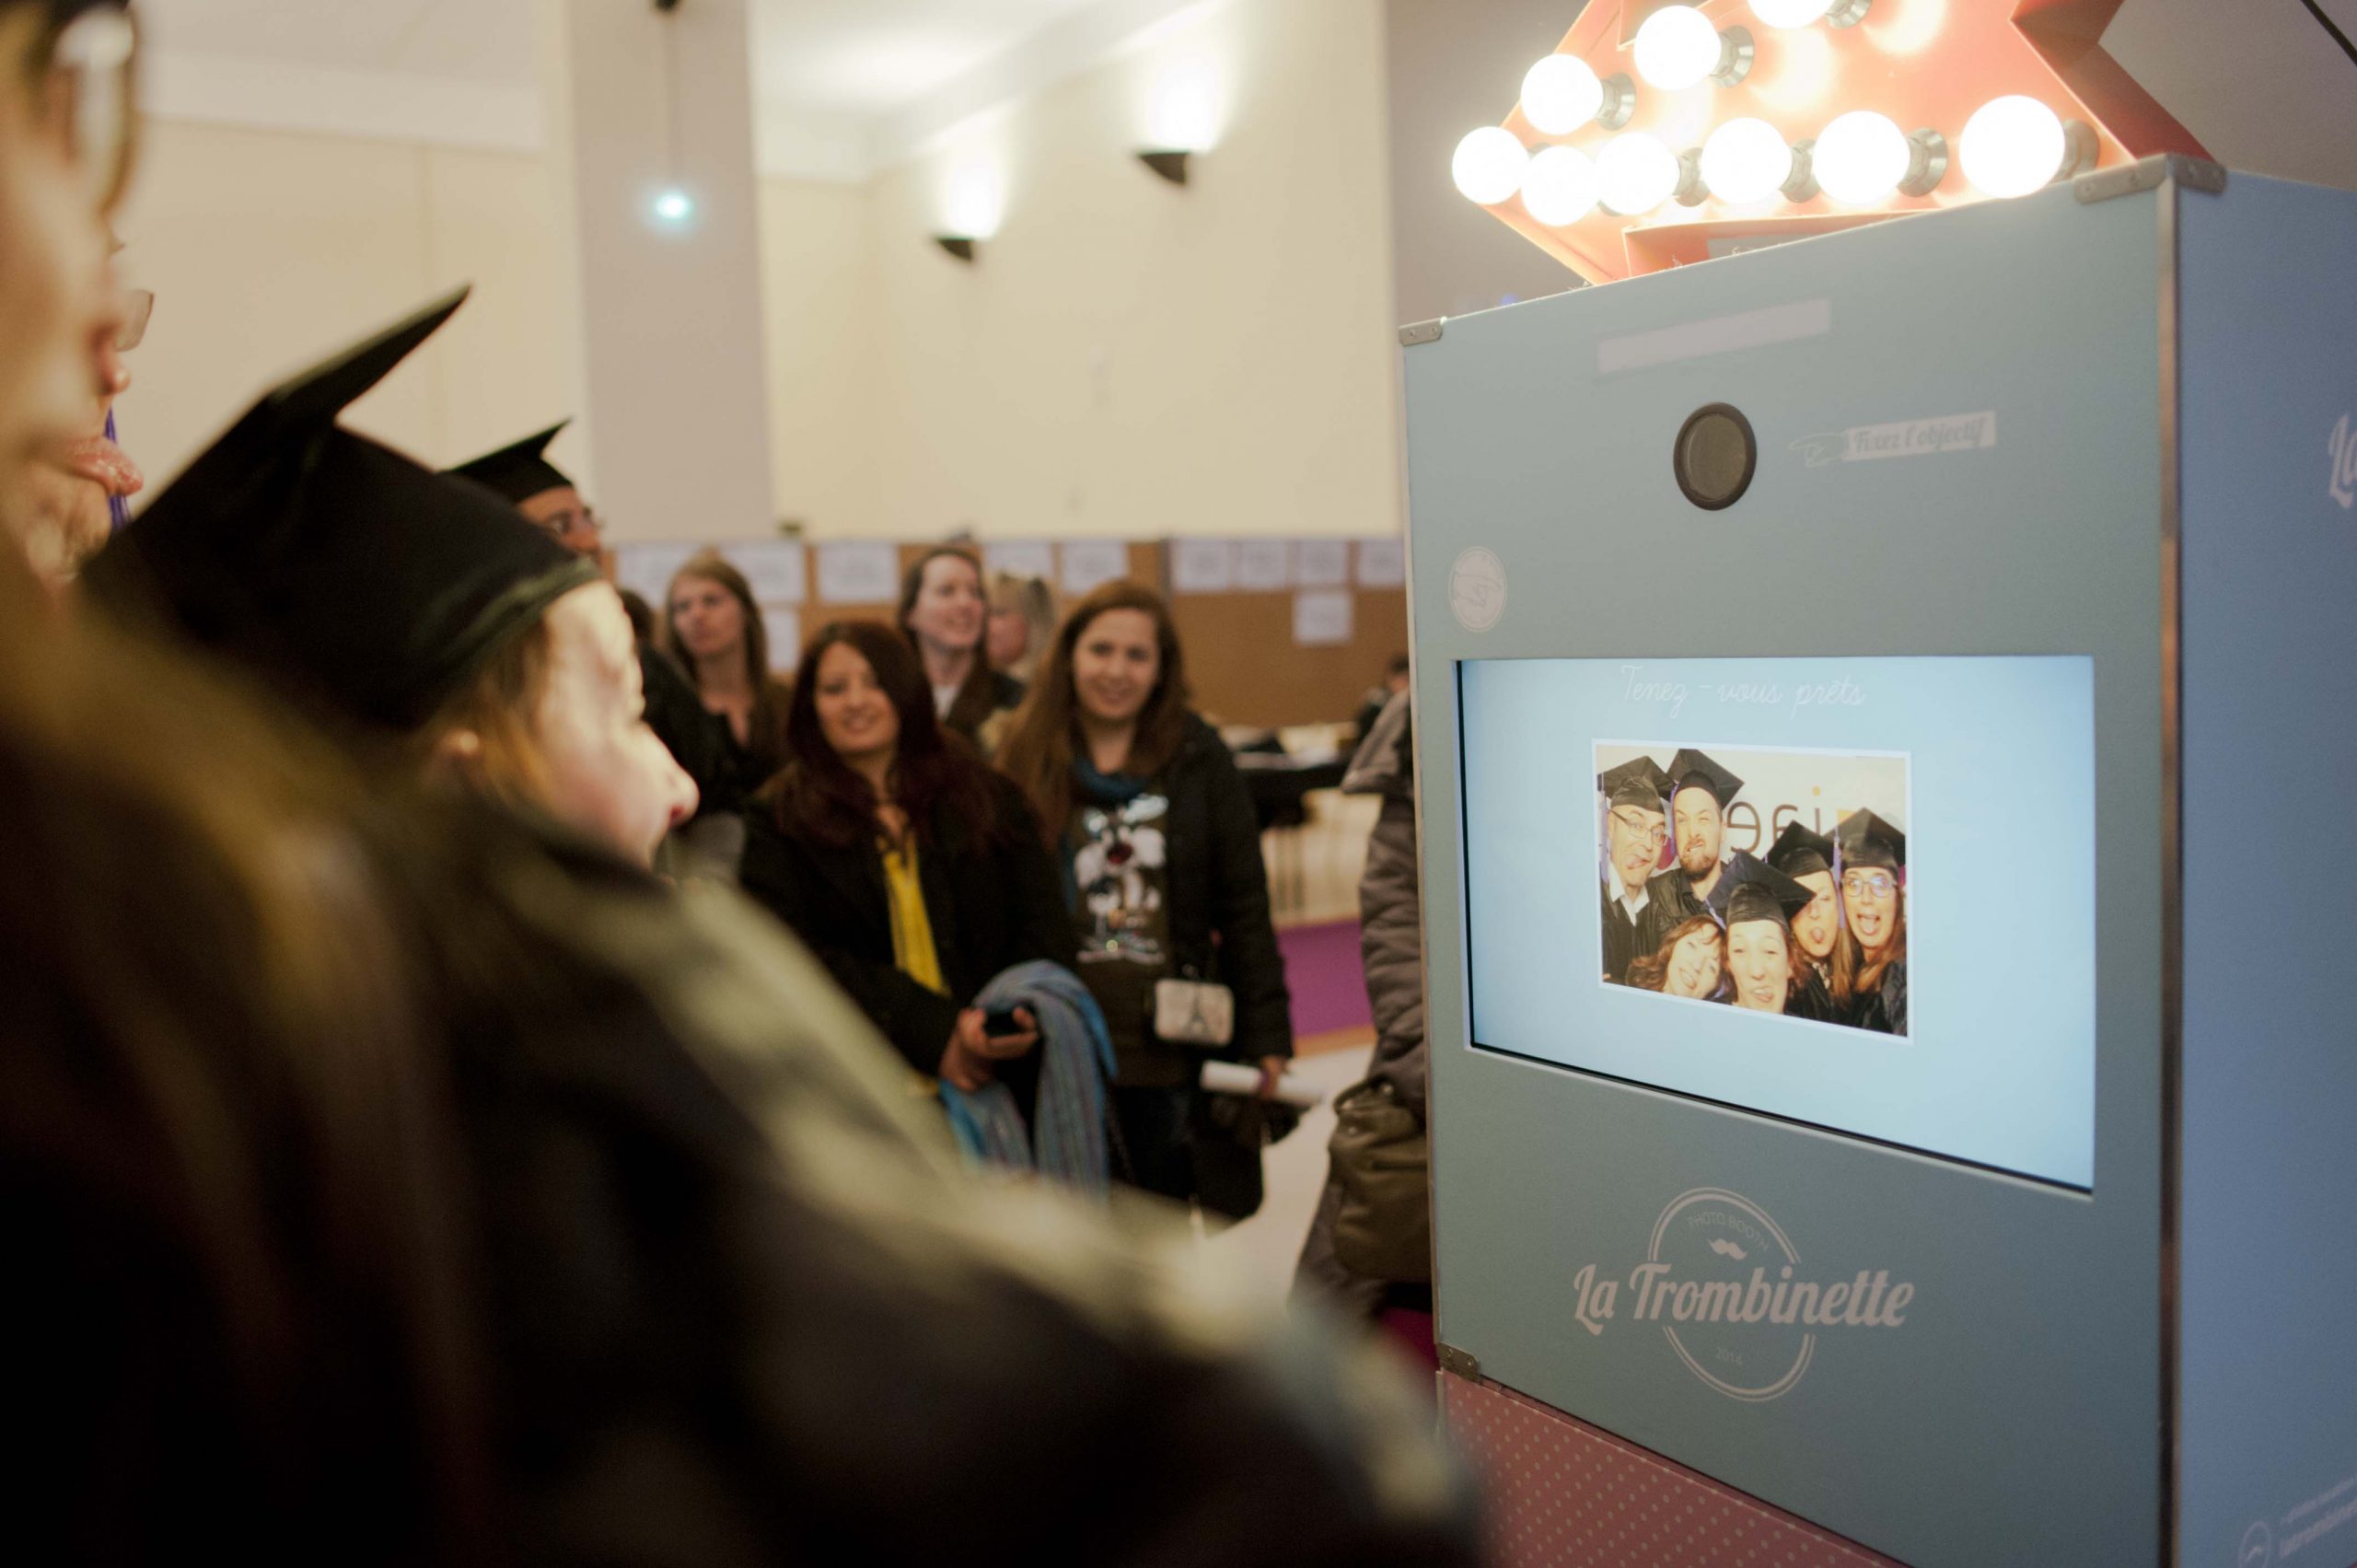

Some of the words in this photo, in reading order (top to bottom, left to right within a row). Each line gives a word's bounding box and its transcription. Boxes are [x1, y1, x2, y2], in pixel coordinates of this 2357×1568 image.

[1790, 674, 1868, 720] prêts
[1573, 1263, 1618, 1336] La
[1629, 1261, 1915, 1328] Trombinette
